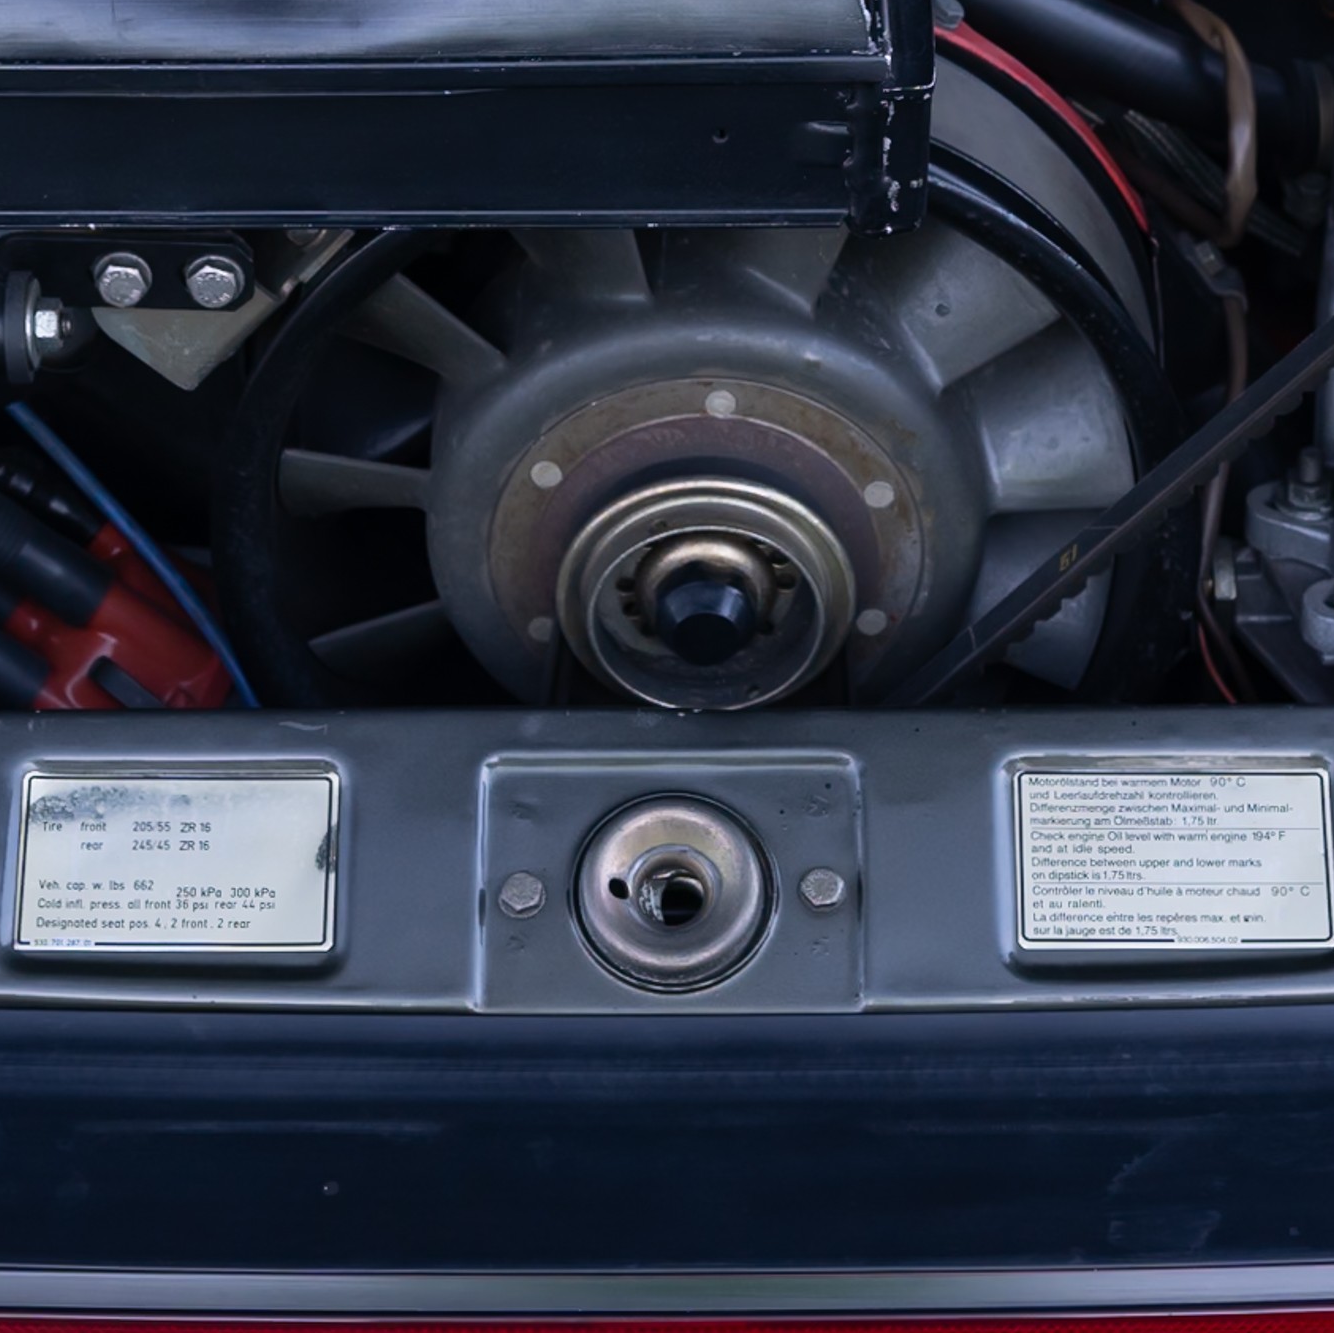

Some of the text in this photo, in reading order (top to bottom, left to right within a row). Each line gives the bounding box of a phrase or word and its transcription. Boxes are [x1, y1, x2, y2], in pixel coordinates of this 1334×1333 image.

[1236, 776, 1246, 787] C
[43, 821, 62, 831] Tire
[80, 821, 106, 832] front
[180, 822, 196, 833] ZR
[200, 822, 211, 833] 16
[1278, 830, 1285, 840] F
[80, 842, 103, 850] rear
[179, 840, 195, 851] ZR
[199, 840, 210, 850] 16
[1057, 844, 1068, 853] at
[1031, 872, 1046, 880] on
[109, 880, 125, 890] lbs
[133, 880, 154, 891] 662
[1085, 886, 1095, 895] le
[1300, 885, 1310, 897] C
[176, 886, 275, 898] 250 kPa 300 kPa
[37, 898, 62, 909] Cold
[127, 899, 140, 909] all
[145, 899, 171, 909] front
[176, 899, 189, 910] 36
[192, 902, 208, 911] psi
[215, 901, 237, 909] rear
[242, 899, 255, 909] 44
[259, 902, 275, 911] psi
[1033, 899, 1043, 909] et
[1049, 901, 1062, 909] au
[1033, 912, 1047, 922] La
[1230, 914, 1240, 923] et
[36, 917, 98, 930] Designated
[101, 919, 125, 928] seat
[1053, 925, 1063, 935] la
[1118, 926, 1132, 935] de
